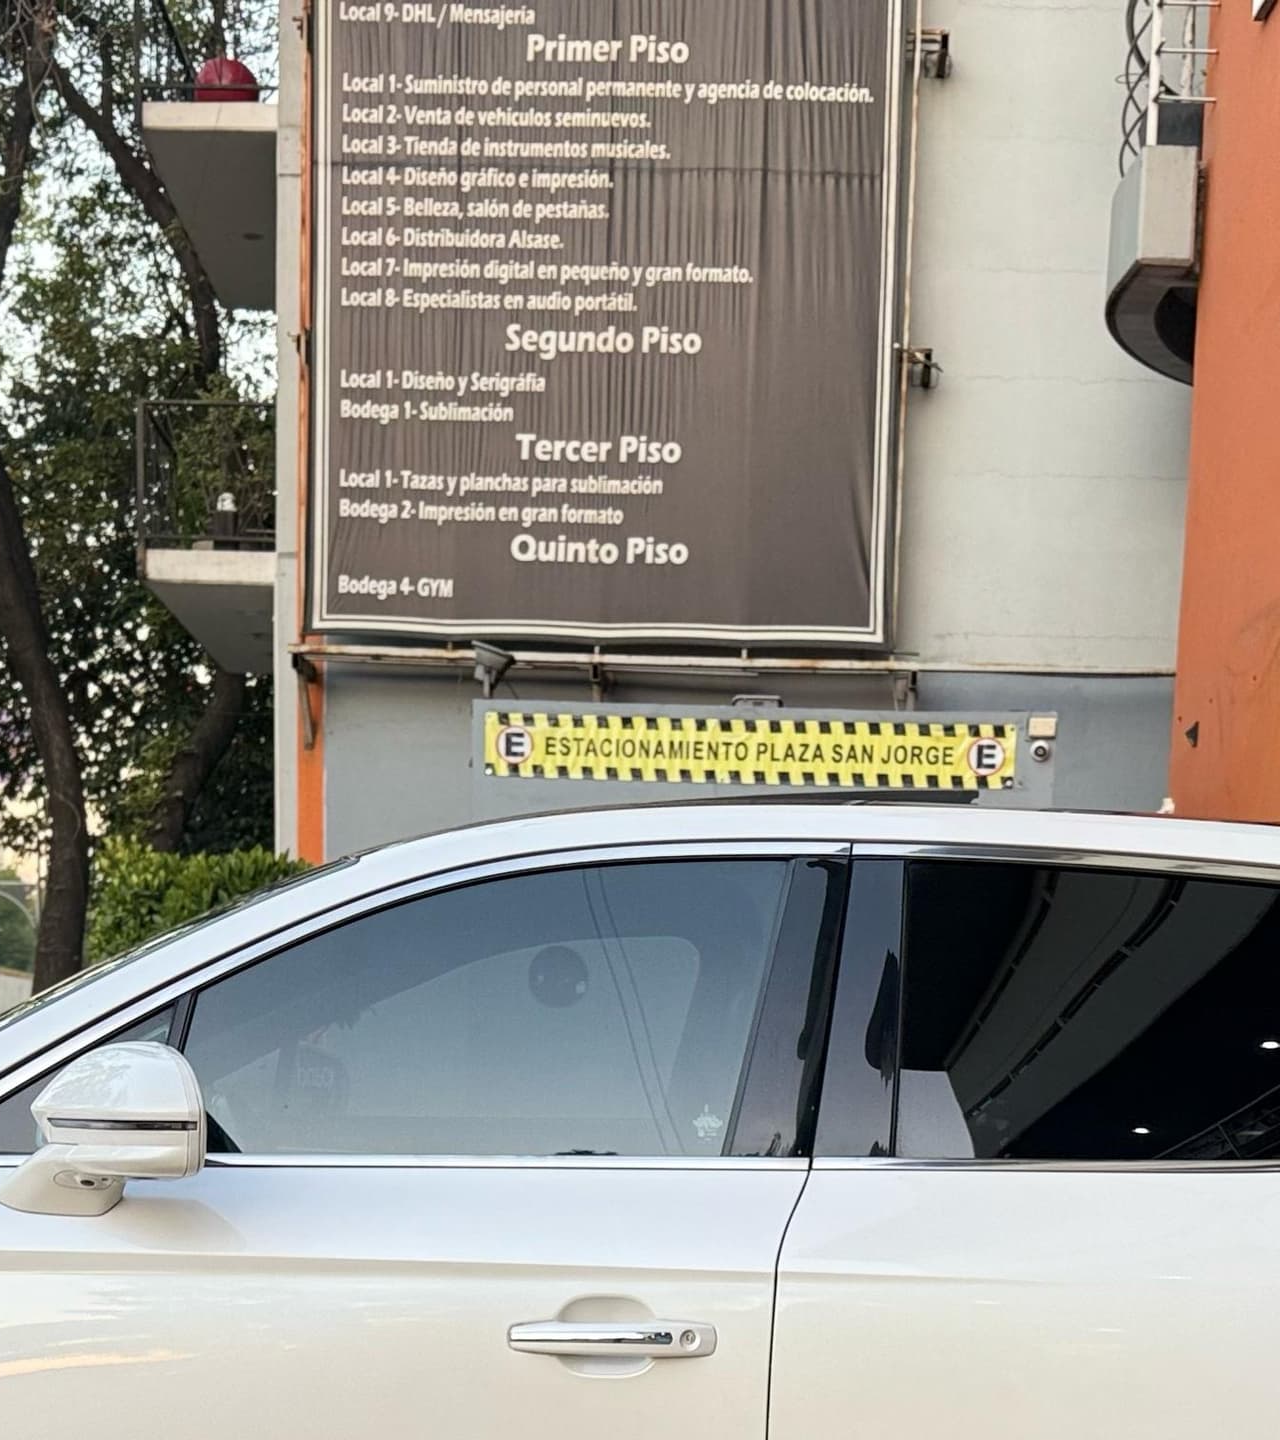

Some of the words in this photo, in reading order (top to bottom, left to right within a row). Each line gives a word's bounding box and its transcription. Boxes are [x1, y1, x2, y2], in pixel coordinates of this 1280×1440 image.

[339, 2, 380, 21] Local
[402, 5, 436, 23] DHL
[527, 34, 622, 62] Primer
[629, 35, 689, 63] Piso
[343, 73, 383, 93] Local
[405, 74, 488, 95] Suministro
[491, 76, 511, 96] de
[514, 77, 582, 101] personal
[586, 80, 681, 101] permanente
[684, 82, 695, 103] y
[698, 80, 759, 103] agencia
[763, 81, 782, 100] de
[786, 82, 874, 103] colocación.
[343, 104, 383, 123] Local
[404, 105, 451, 125] Venta
[455, 106, 474, 126] de
[555, 108, 651, 128] seminuevos.
[342, 134, 382, 154] Local
[404, 136, 457, 156] Tienda
[461, 138, 481, 157] de
[484, 138, 588, 159] instrumentos
[591, 140, 670, 160] musicales.
[342, 166, 382, 185] Local
[404, 167, 458, 187] Diseño
[461, 168, 515, 192] gráfico
[519, 174, 529, 188] e
[532, 170, 613, 193] impresión.
[342, 197, 382, 216] Local
[404, 198, 464, 220] Belleza,
[467, 199, 508, 218] salón
[512, 200, 531, 219] de
[535, 200, 610, 224] pestañas.
[341, 227, 382, 246] Local
[403, 228, 505, 248] Distribuidora
[508, 230, 564, 249] Alsase.
[341, 257, 381, 276] Local
[403, 258, 480, 283] Impresión
[483, 260, 534, 285] digital
[537, 264, 557, 280] en
[560, 262, 630, 286] pequeño
[632, 267, 642, 287] y
[645, 267, 682, 287] gran
[686, 263, 754, 284] formato.
[341, 288, 381, 307] Local
[402, 289, 500, 313] Especialistas
[504, 295, 523, 310] en
[527, 291, 572, 311] audio
[574, 292, 638, 316] portátil.
[505, 324, 634, 360] Segundo
[642, 326, 702, 354] Piso
[340, 369, 381, 389] Local
[402, 371, 455, 392] Diseño
[457, 376, 468, 396] y
[340, 399, 399, 425] Bodega
[420, 401, 514, 422] Sublimación
[516, 434, 612, 462] Tercer
[620, 436, 682, 464] Piso
[339, 469, 380, 488] Local
[401, 470, 444, 490] Tazas
[446, 476, 456, 496] y
[459, 473, 528, 496] planchas
[531, 480, 567, 497] para
[570, 475, 663, 495] sublimación
[339, 499, 398, 523] Bodega
[418, 501, 496, 525] Impresión
[499, 507, 518, 522] en
[521, 508, 559, 528] gran
[561, 504, 624, 525] formato
[511, 534, 619, 564] Quinto
[626, 537, 689, 565] Piso
[338, 575, 397, 600] Bodega
[417, 578, 453, 598] GYM
[505, 733, 525, 757] E
[545, 736, 748, 761] ESTACIONAMIENTO
[756, 742, 825, 763] PLAZA
[831, 744, 873, 763] SAN
[881, 746, 954, 766] JORGE
[976, 744, 997, 769] E
